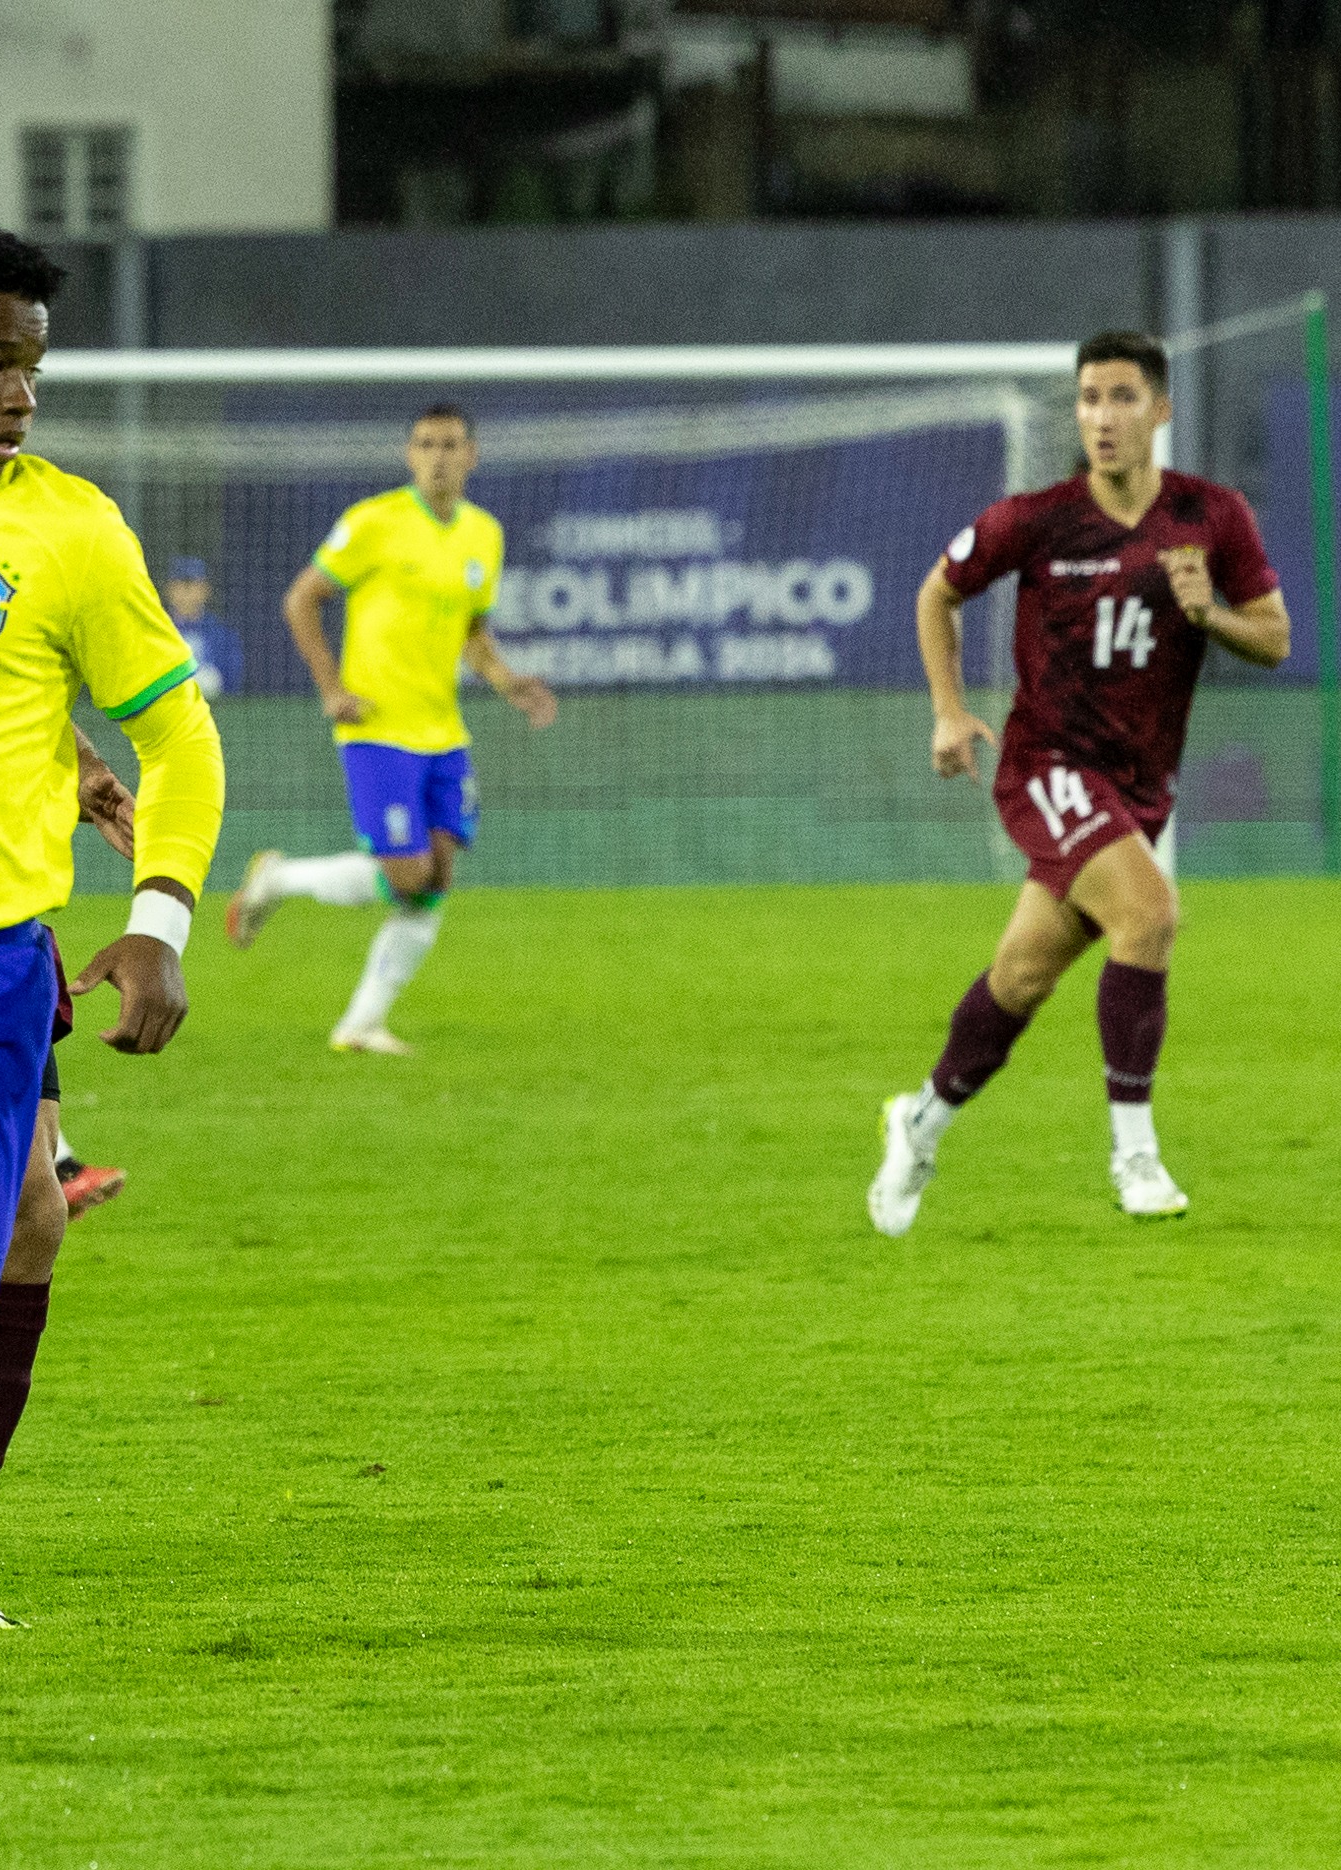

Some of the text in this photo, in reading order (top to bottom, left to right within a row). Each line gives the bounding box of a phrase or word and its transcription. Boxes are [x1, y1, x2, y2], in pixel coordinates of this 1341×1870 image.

[493, 557, 874, 628] EOLIMPICO
[1093, 596, 1157, 669] 14
[1027, 766, 1092, 839] 14
